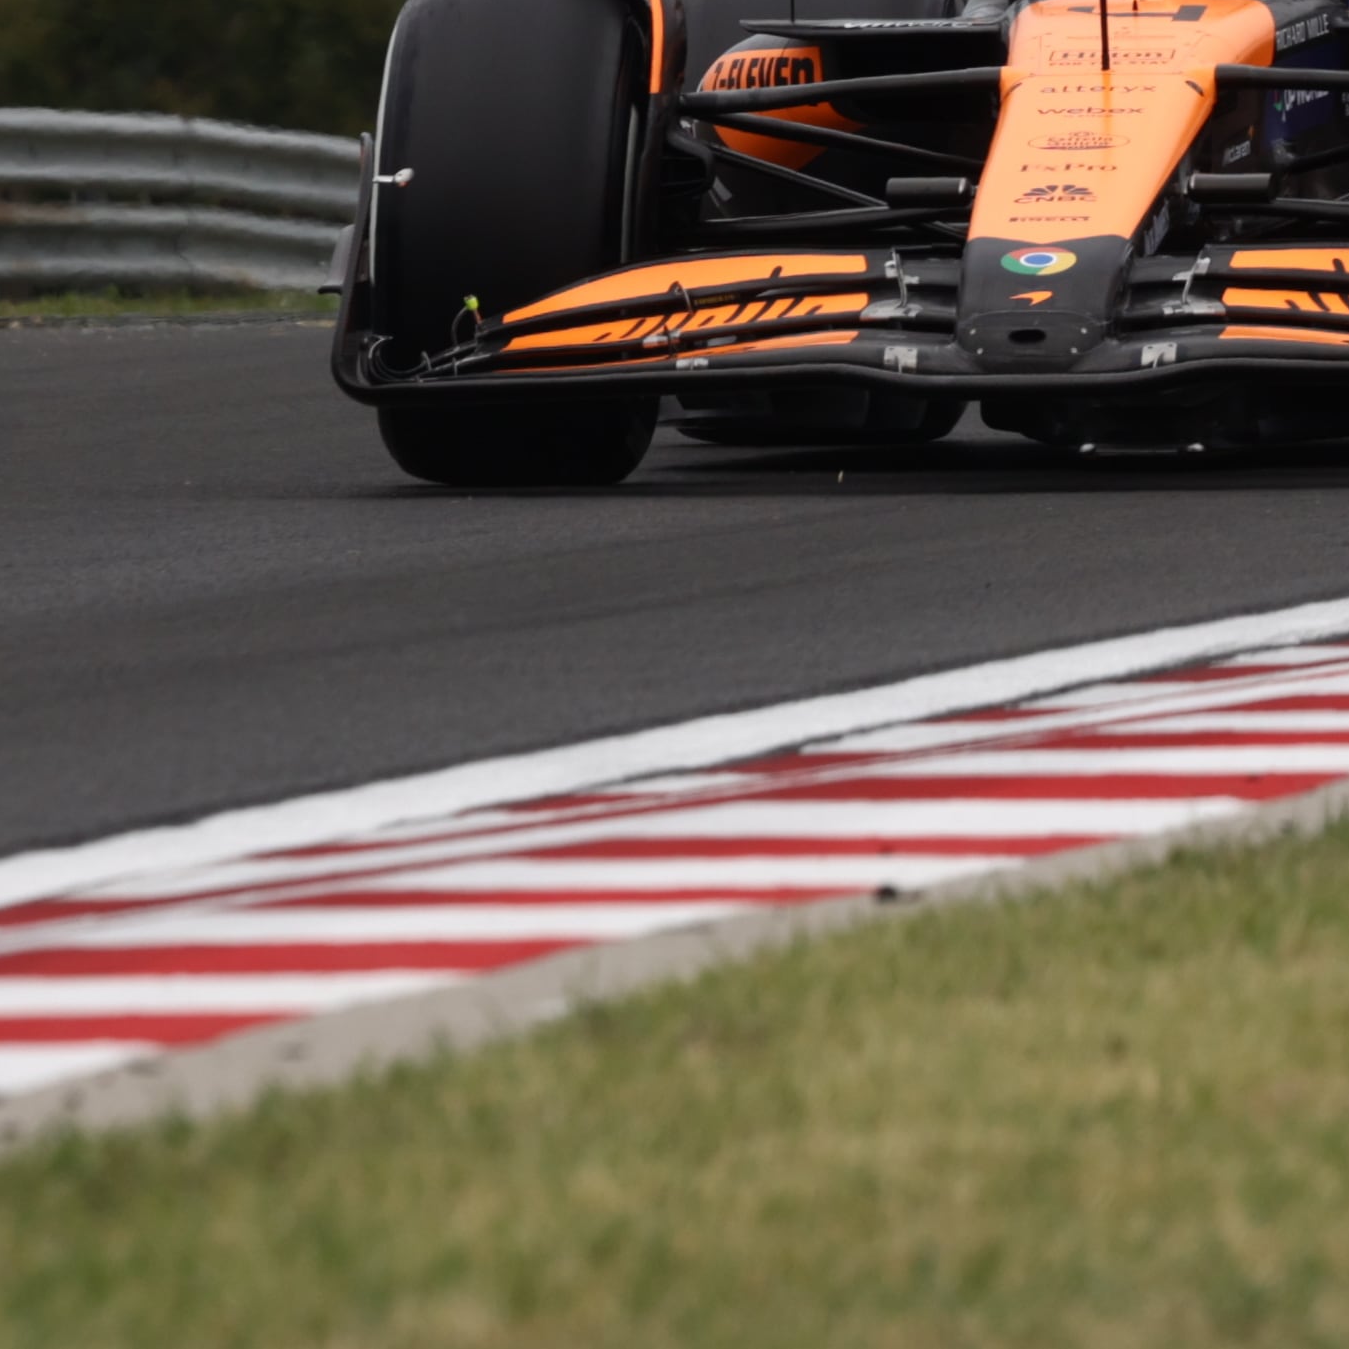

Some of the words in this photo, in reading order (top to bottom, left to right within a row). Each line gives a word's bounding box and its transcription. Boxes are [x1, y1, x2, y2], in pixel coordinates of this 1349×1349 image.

[1275, 21, 1305, 51] RICHARD
[1305, 13, 1330, 42] MILLE
[1061, 51, 1163, 59] Hiton
[1039, 84, 1156, 93] alteryx
[1037, 106, 1146, 115] webex
[1020, 163, 1118, 173] FxPro
[1014, 195, 1098, 204] CNBC
